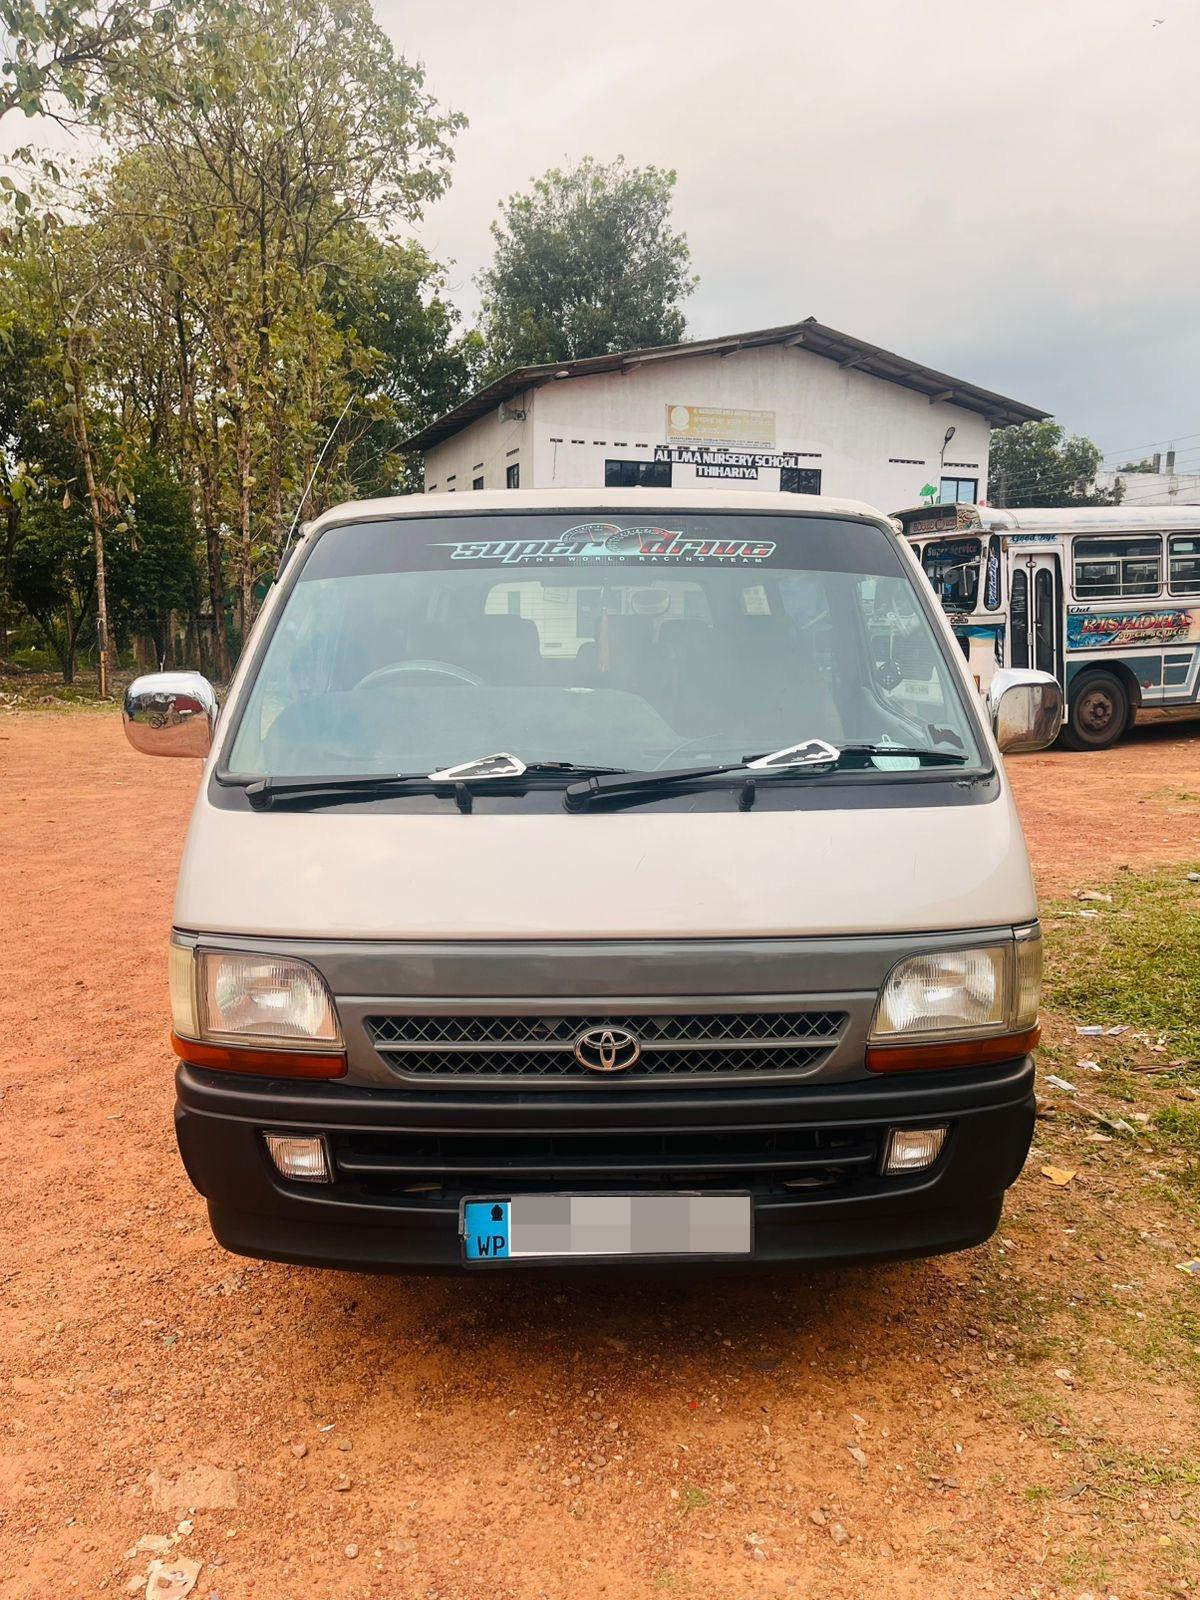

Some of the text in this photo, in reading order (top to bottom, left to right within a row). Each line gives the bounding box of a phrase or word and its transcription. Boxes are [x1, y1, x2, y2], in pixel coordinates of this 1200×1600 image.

[656, 449, 799, 469] AL ILMA NURSERY SCHOOL
[696, 464, 758, 479] THIHARIYA
[477, 1235, 506, 1256] WP
